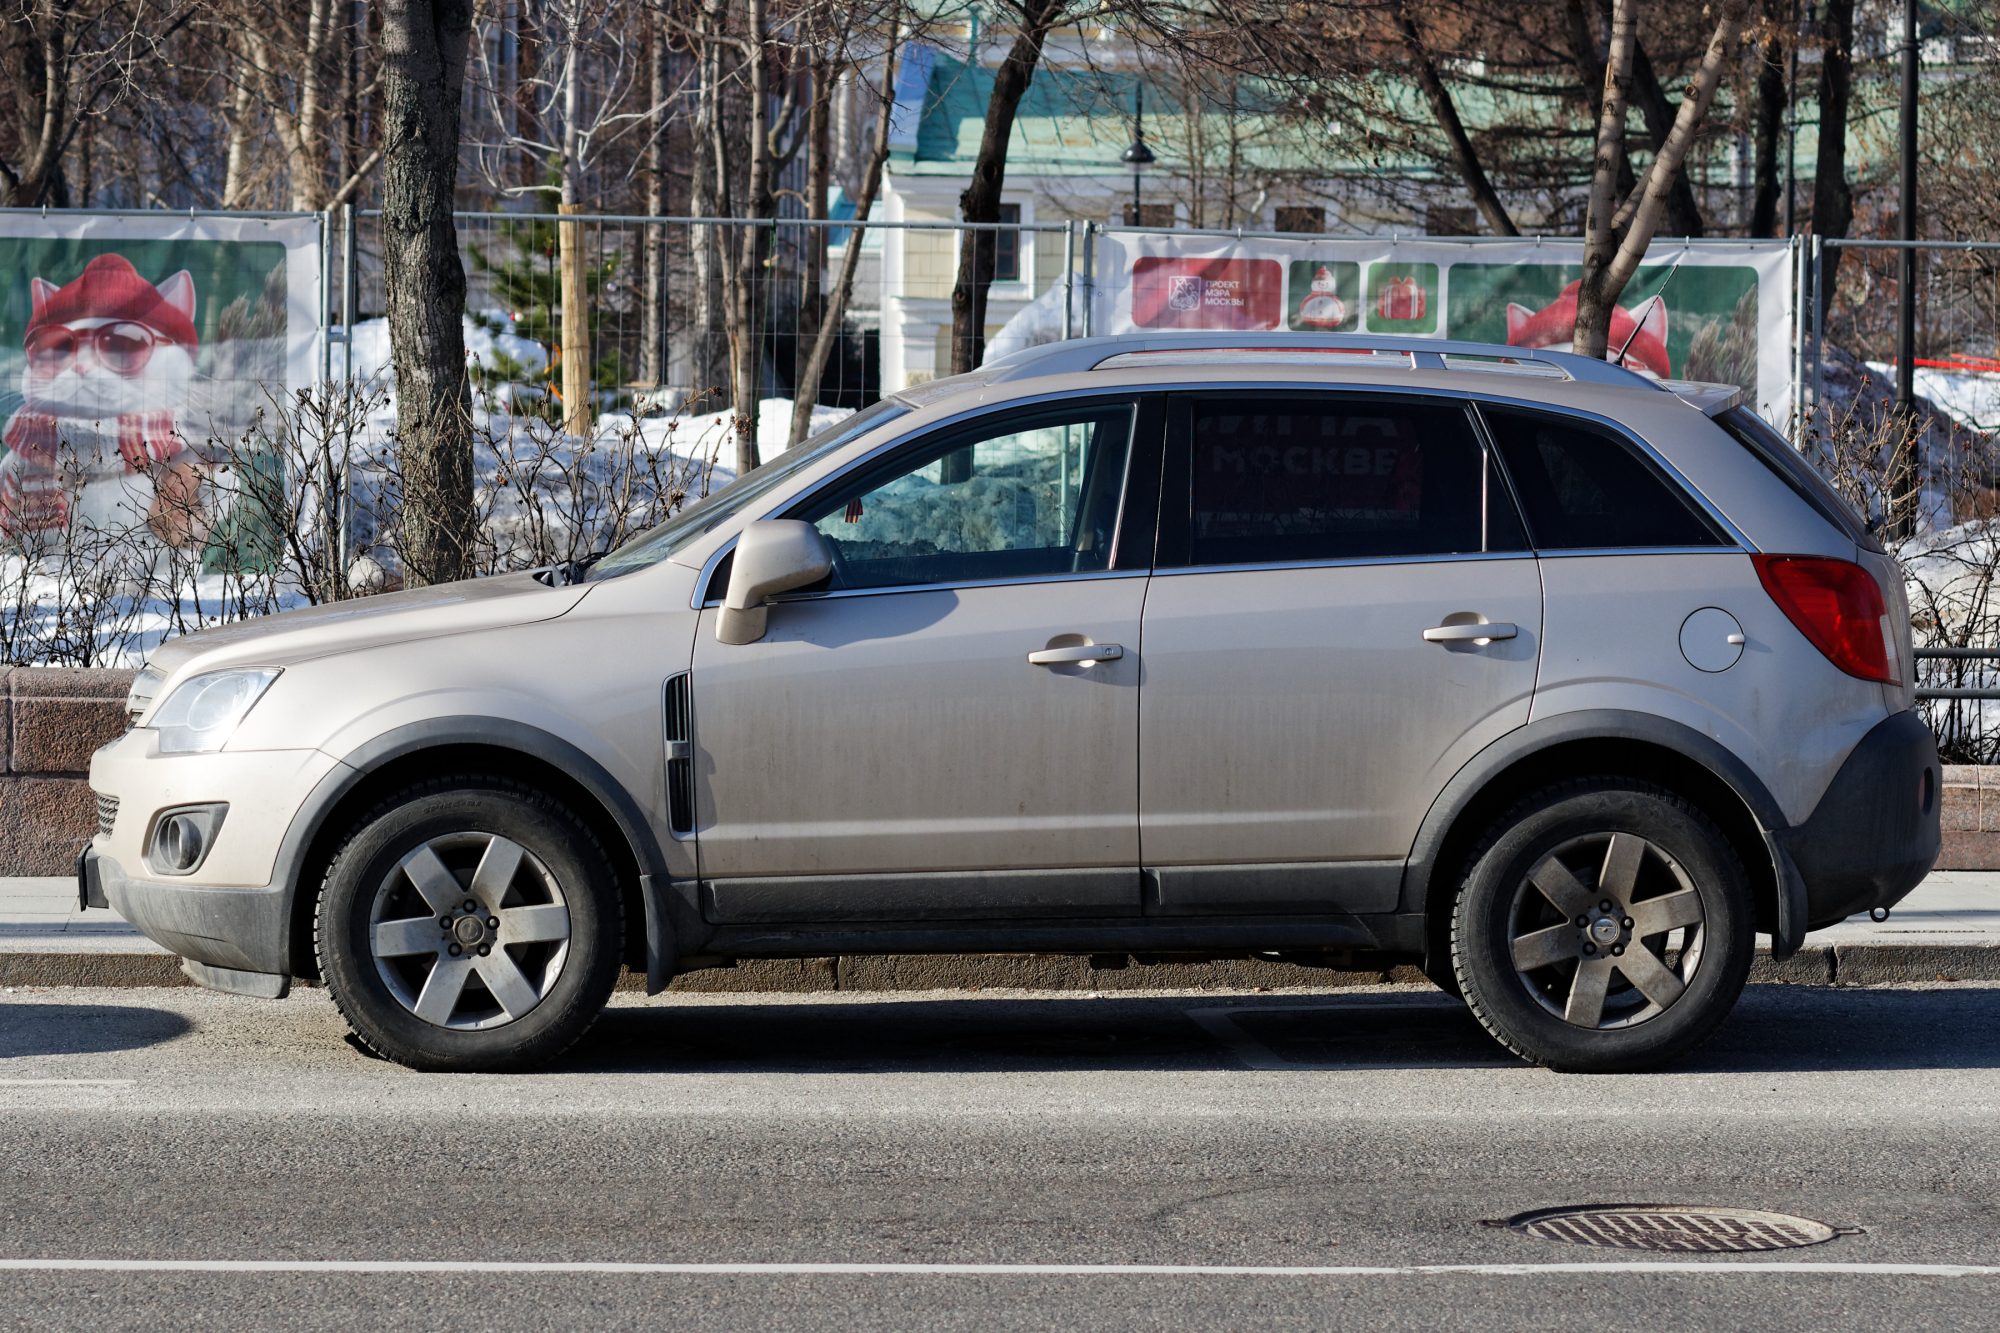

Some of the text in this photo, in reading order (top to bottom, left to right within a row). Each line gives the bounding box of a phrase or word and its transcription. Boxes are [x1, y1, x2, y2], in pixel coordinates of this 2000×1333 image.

[1205, 280, 1240, 289] ПРОЕКТ
[1205, 289, 1231, 297] МЭРА
[1205, 298, 1245, 306] МОСКВЫ
[1213, 445, 1399, 476] МОСКВЕ
